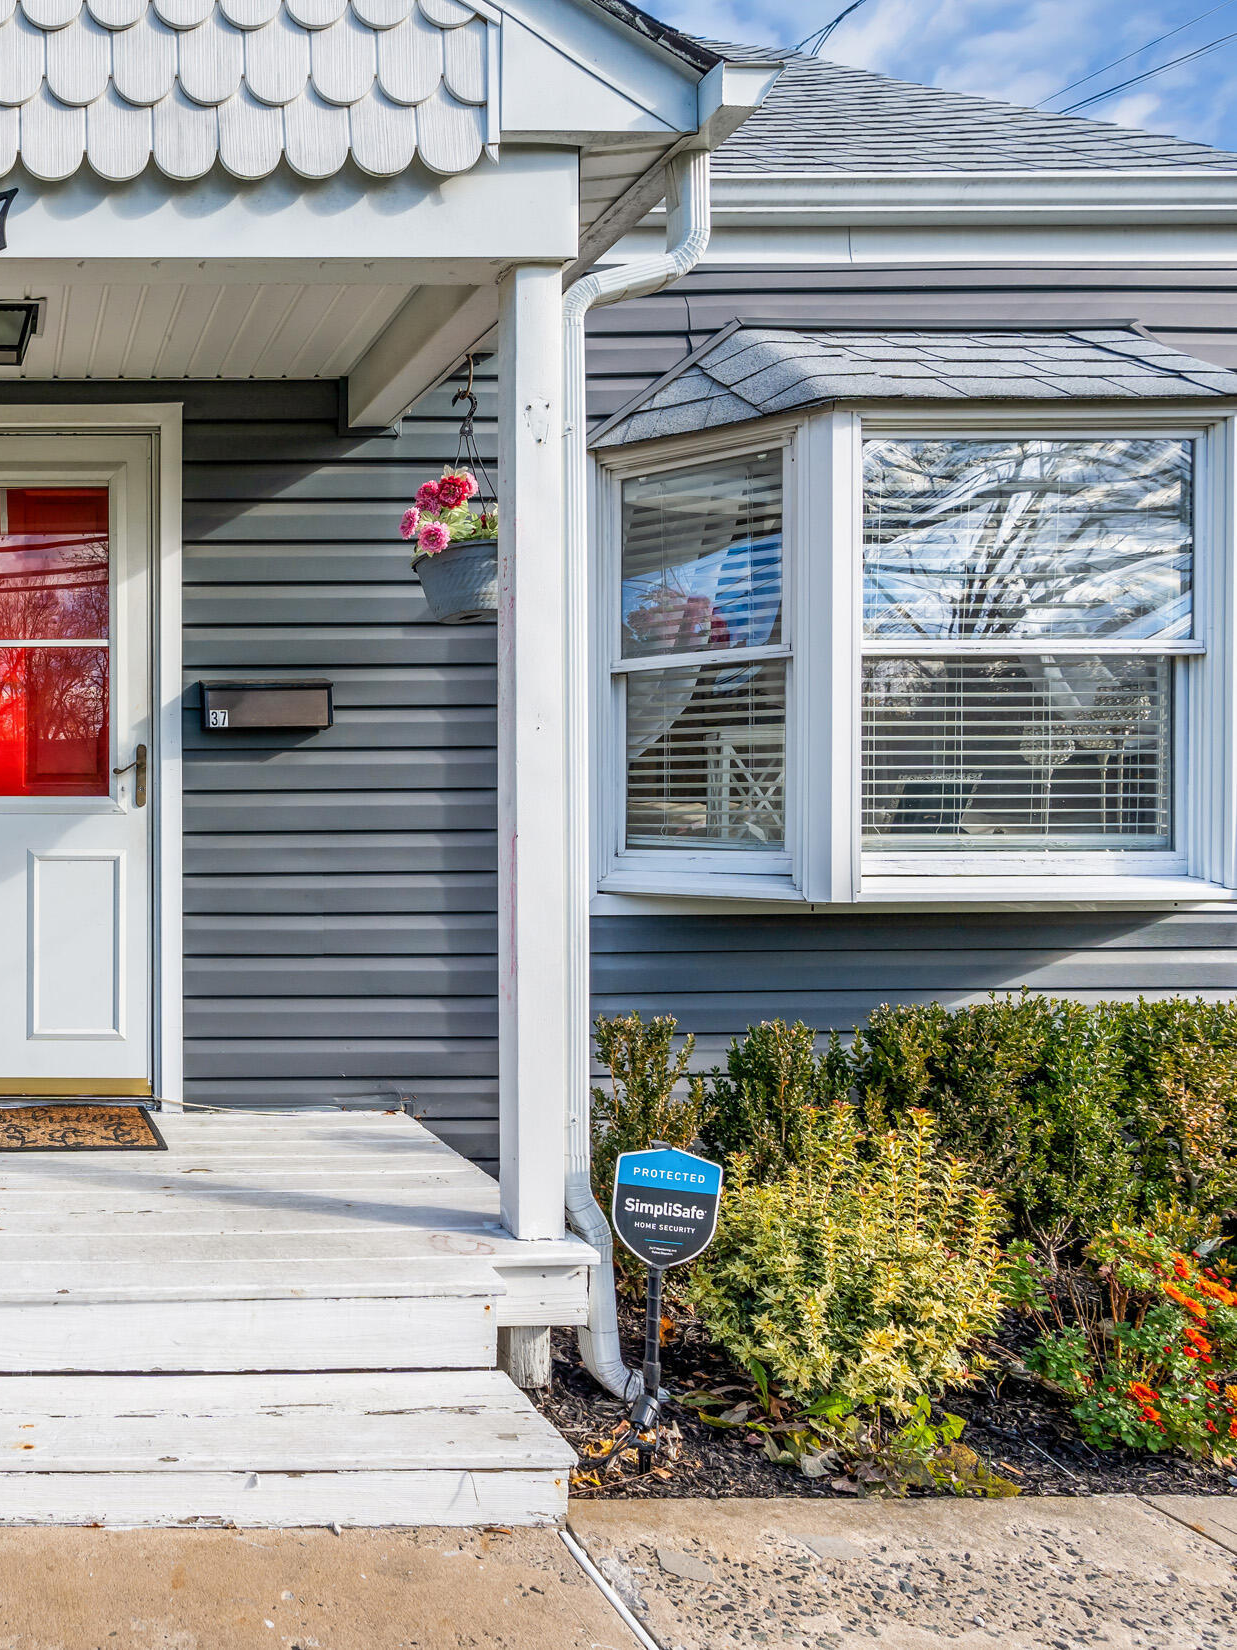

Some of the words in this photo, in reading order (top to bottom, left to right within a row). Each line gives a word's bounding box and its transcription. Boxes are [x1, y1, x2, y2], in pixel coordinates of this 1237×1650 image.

[211, 711, 228, 726] 37
[633, 1166, 706, 1184] PROTECTED
[624, 1197, 706, 1220] SimpliSafe
[634, 1221, 657, 1231] HOME
[659, 1224, 696, 1234] SECURITY
